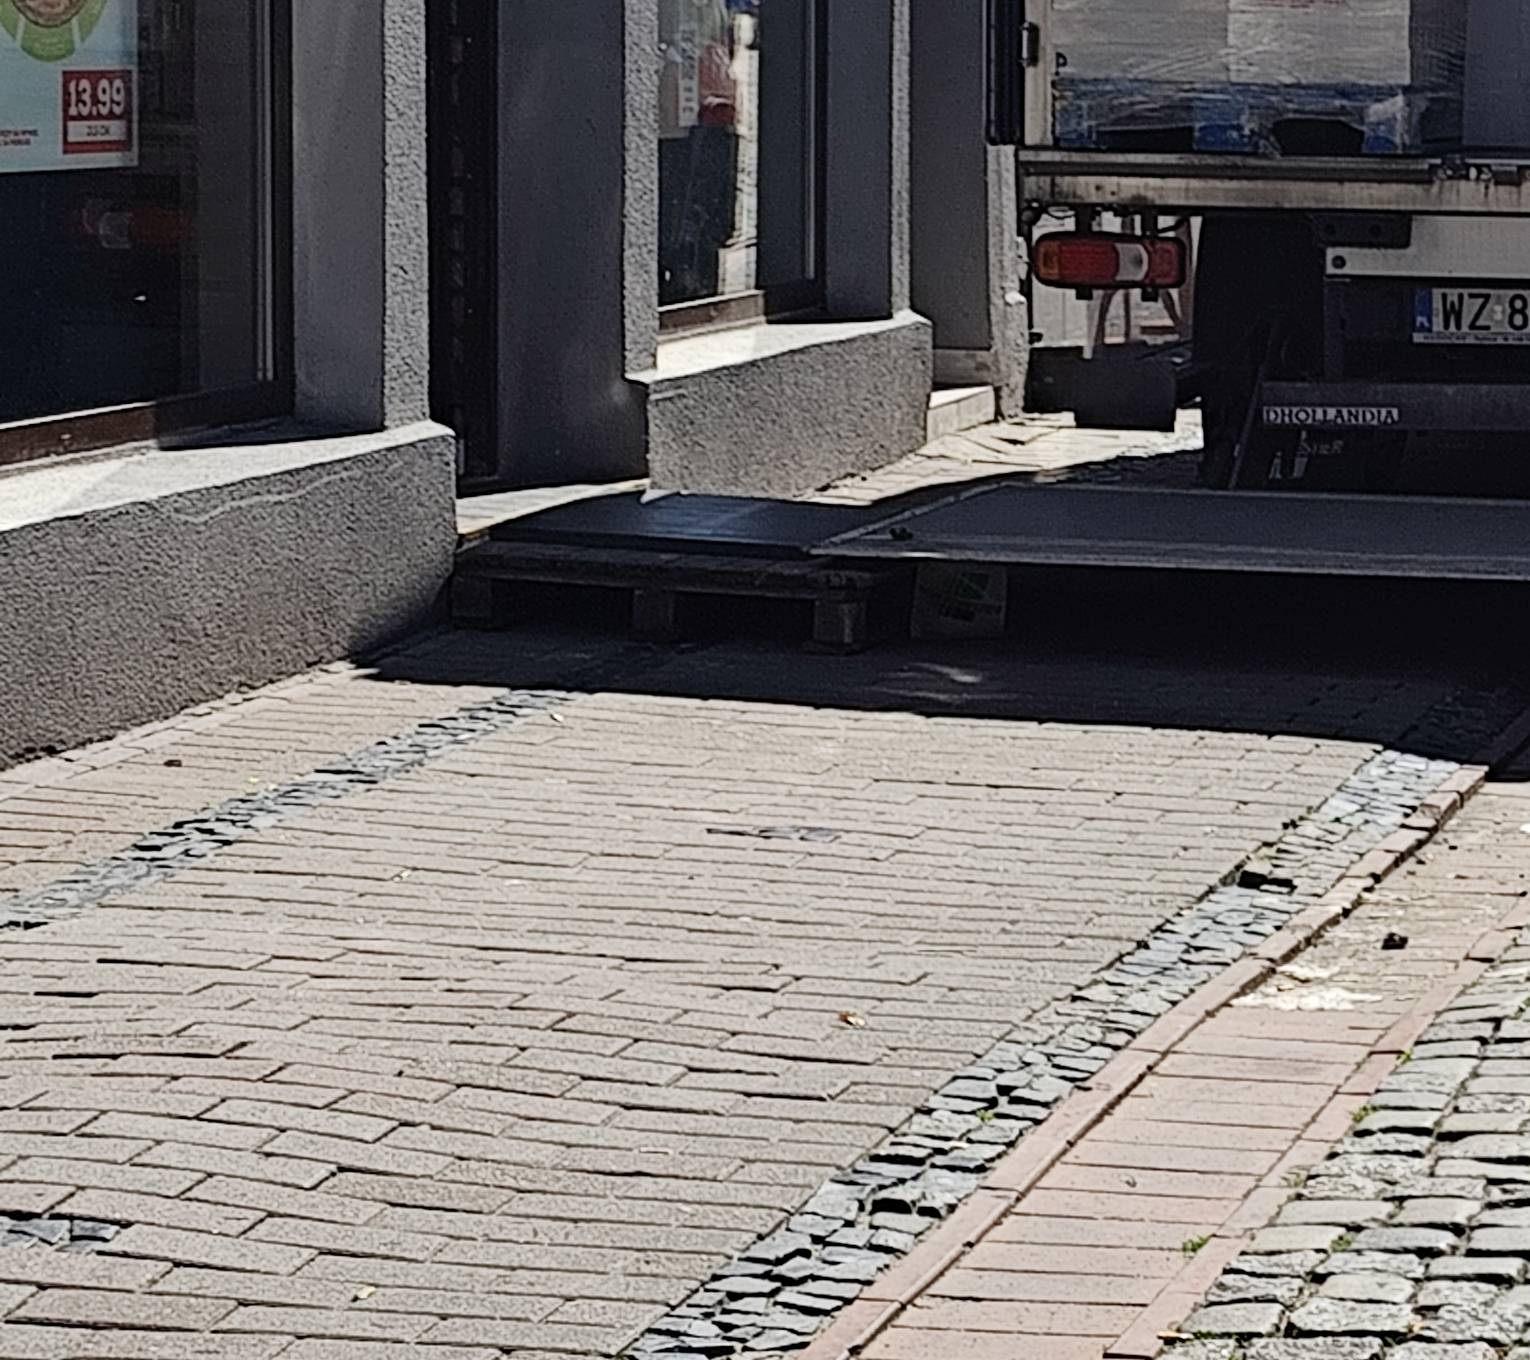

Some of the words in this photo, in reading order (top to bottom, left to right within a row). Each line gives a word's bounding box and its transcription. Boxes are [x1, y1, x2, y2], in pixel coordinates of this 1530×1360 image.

[67, 78, 125, 117] 13.99
[1441, 292, 1492, 332] WZ
[1264, 407, 1399, 426] DHOLLANDIA
